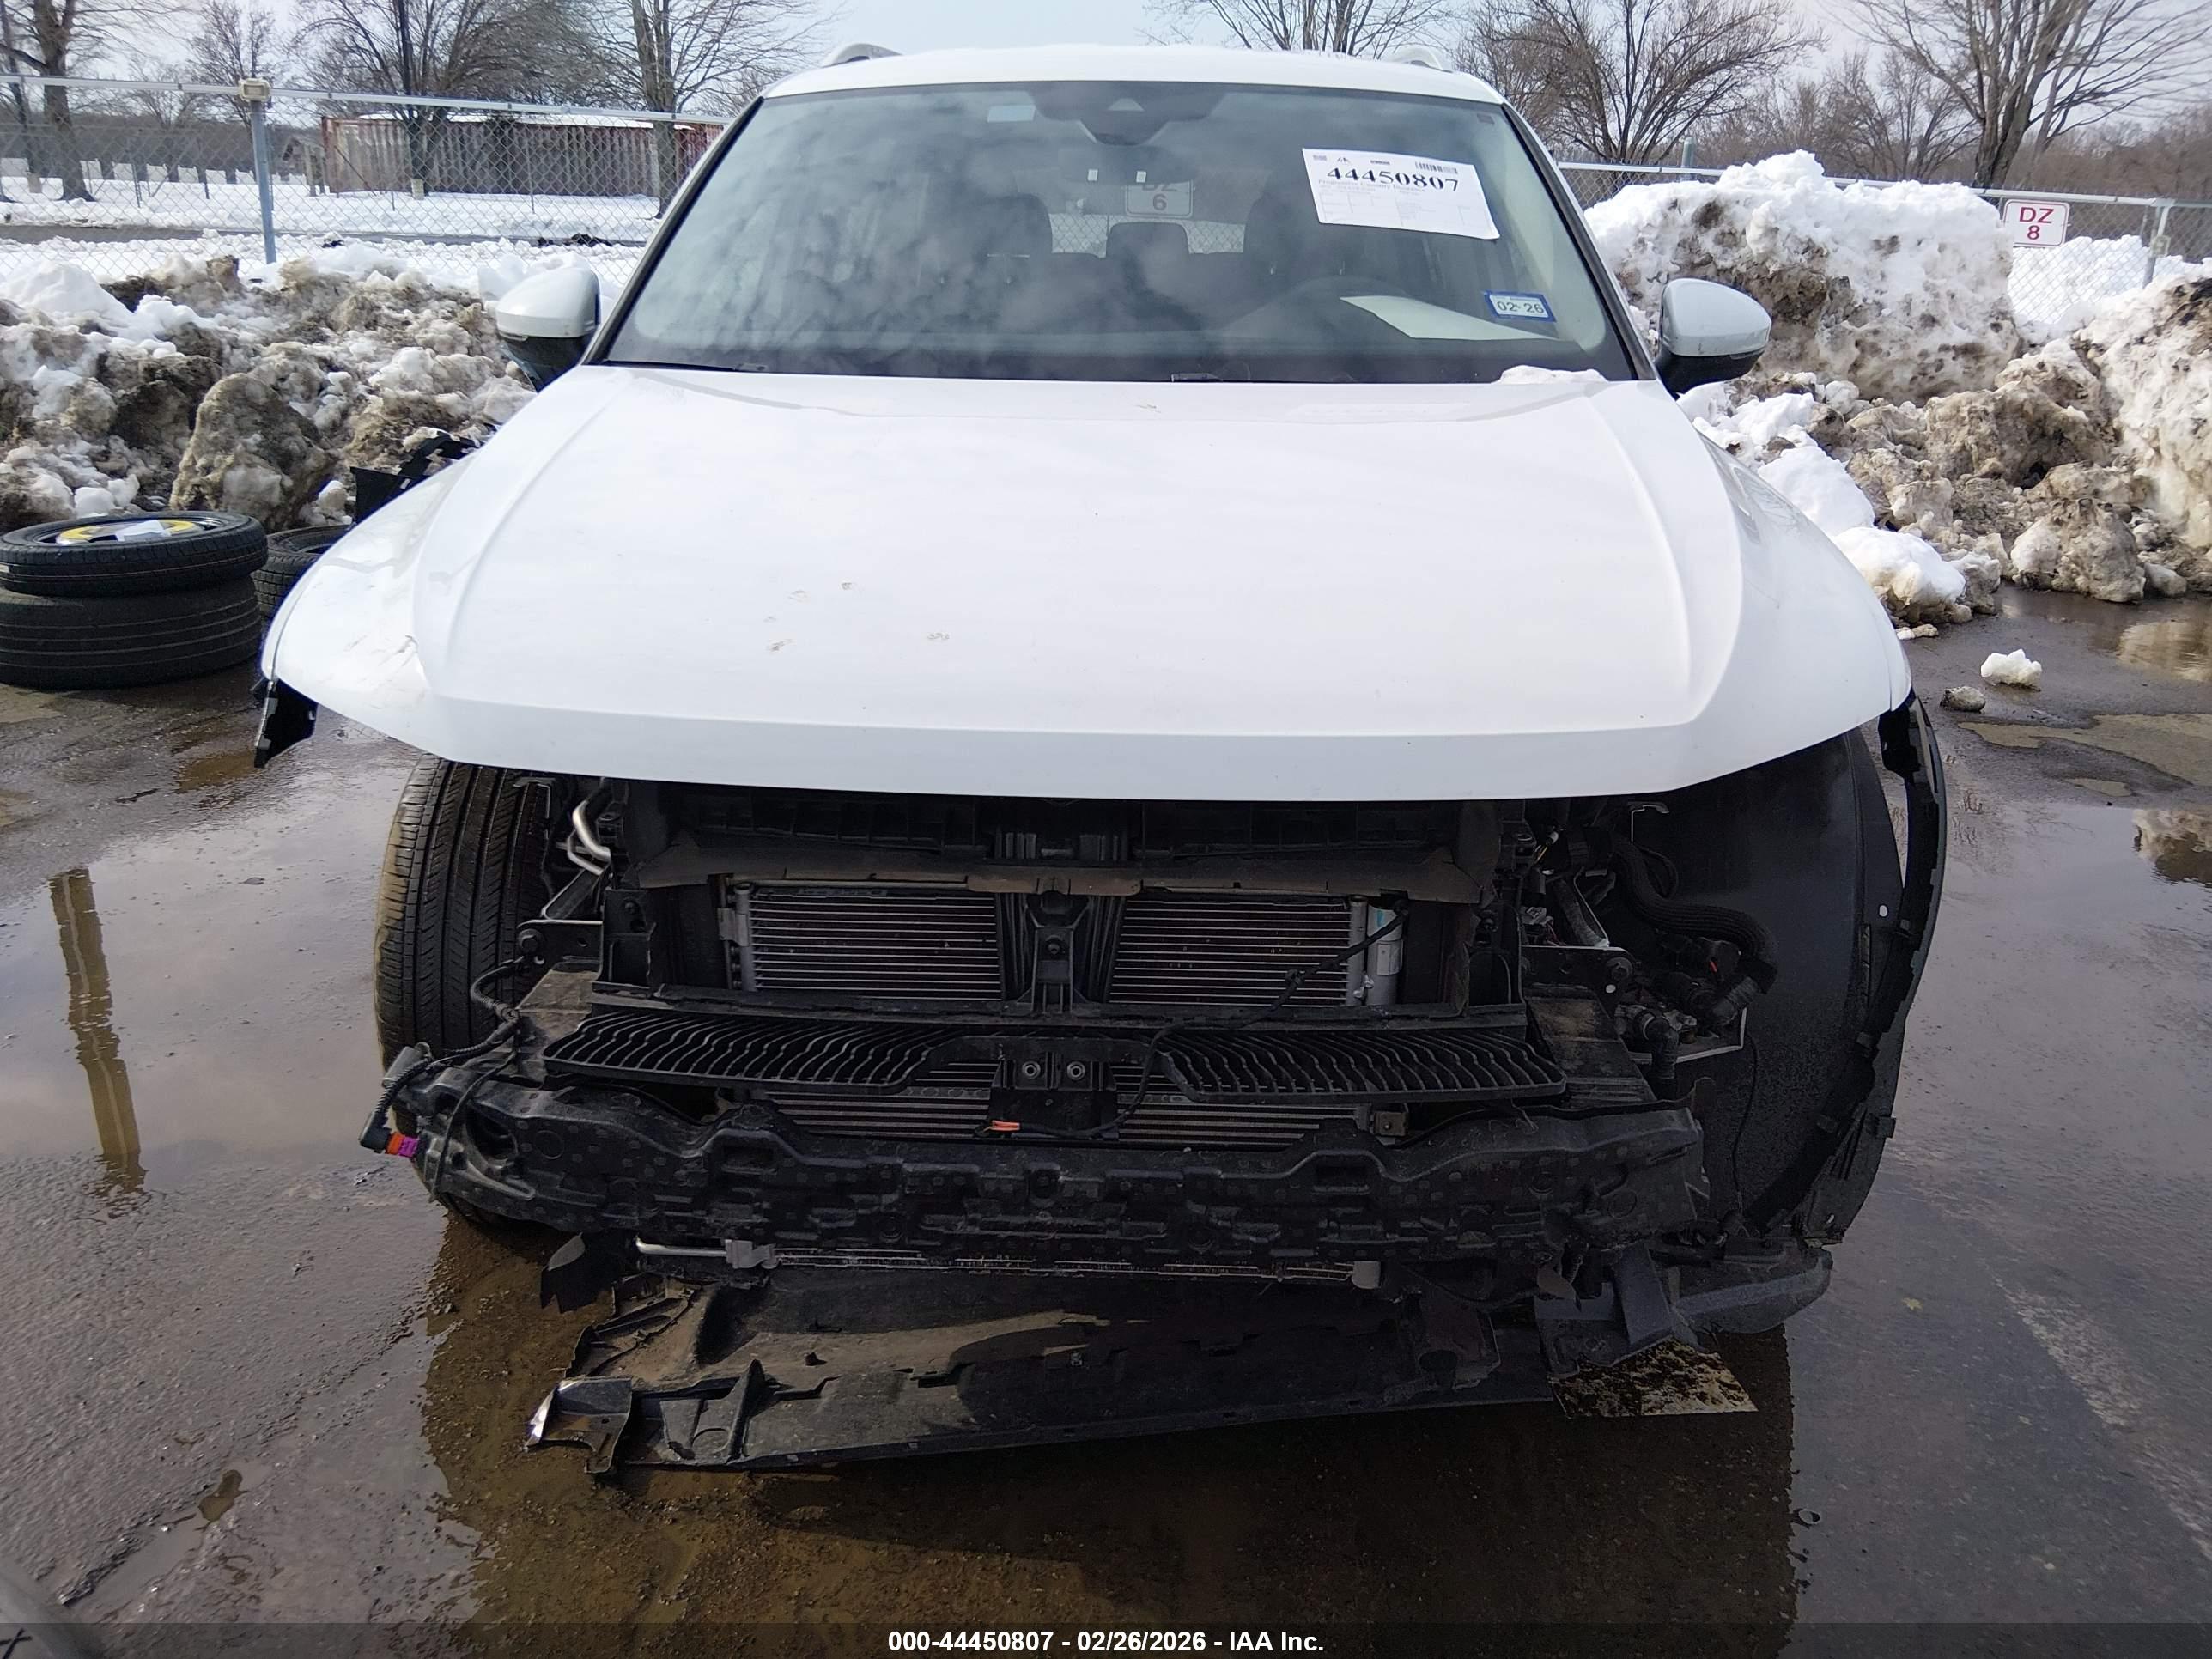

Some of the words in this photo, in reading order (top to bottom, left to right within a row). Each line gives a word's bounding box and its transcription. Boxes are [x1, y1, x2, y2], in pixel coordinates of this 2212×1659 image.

[1328, 167, 1459, 192] 44450807
[1153, 194, 1167, 211] 6
[2019, 206, 2054, 224] DZ
[2027, 225, 2040, 240] 8
